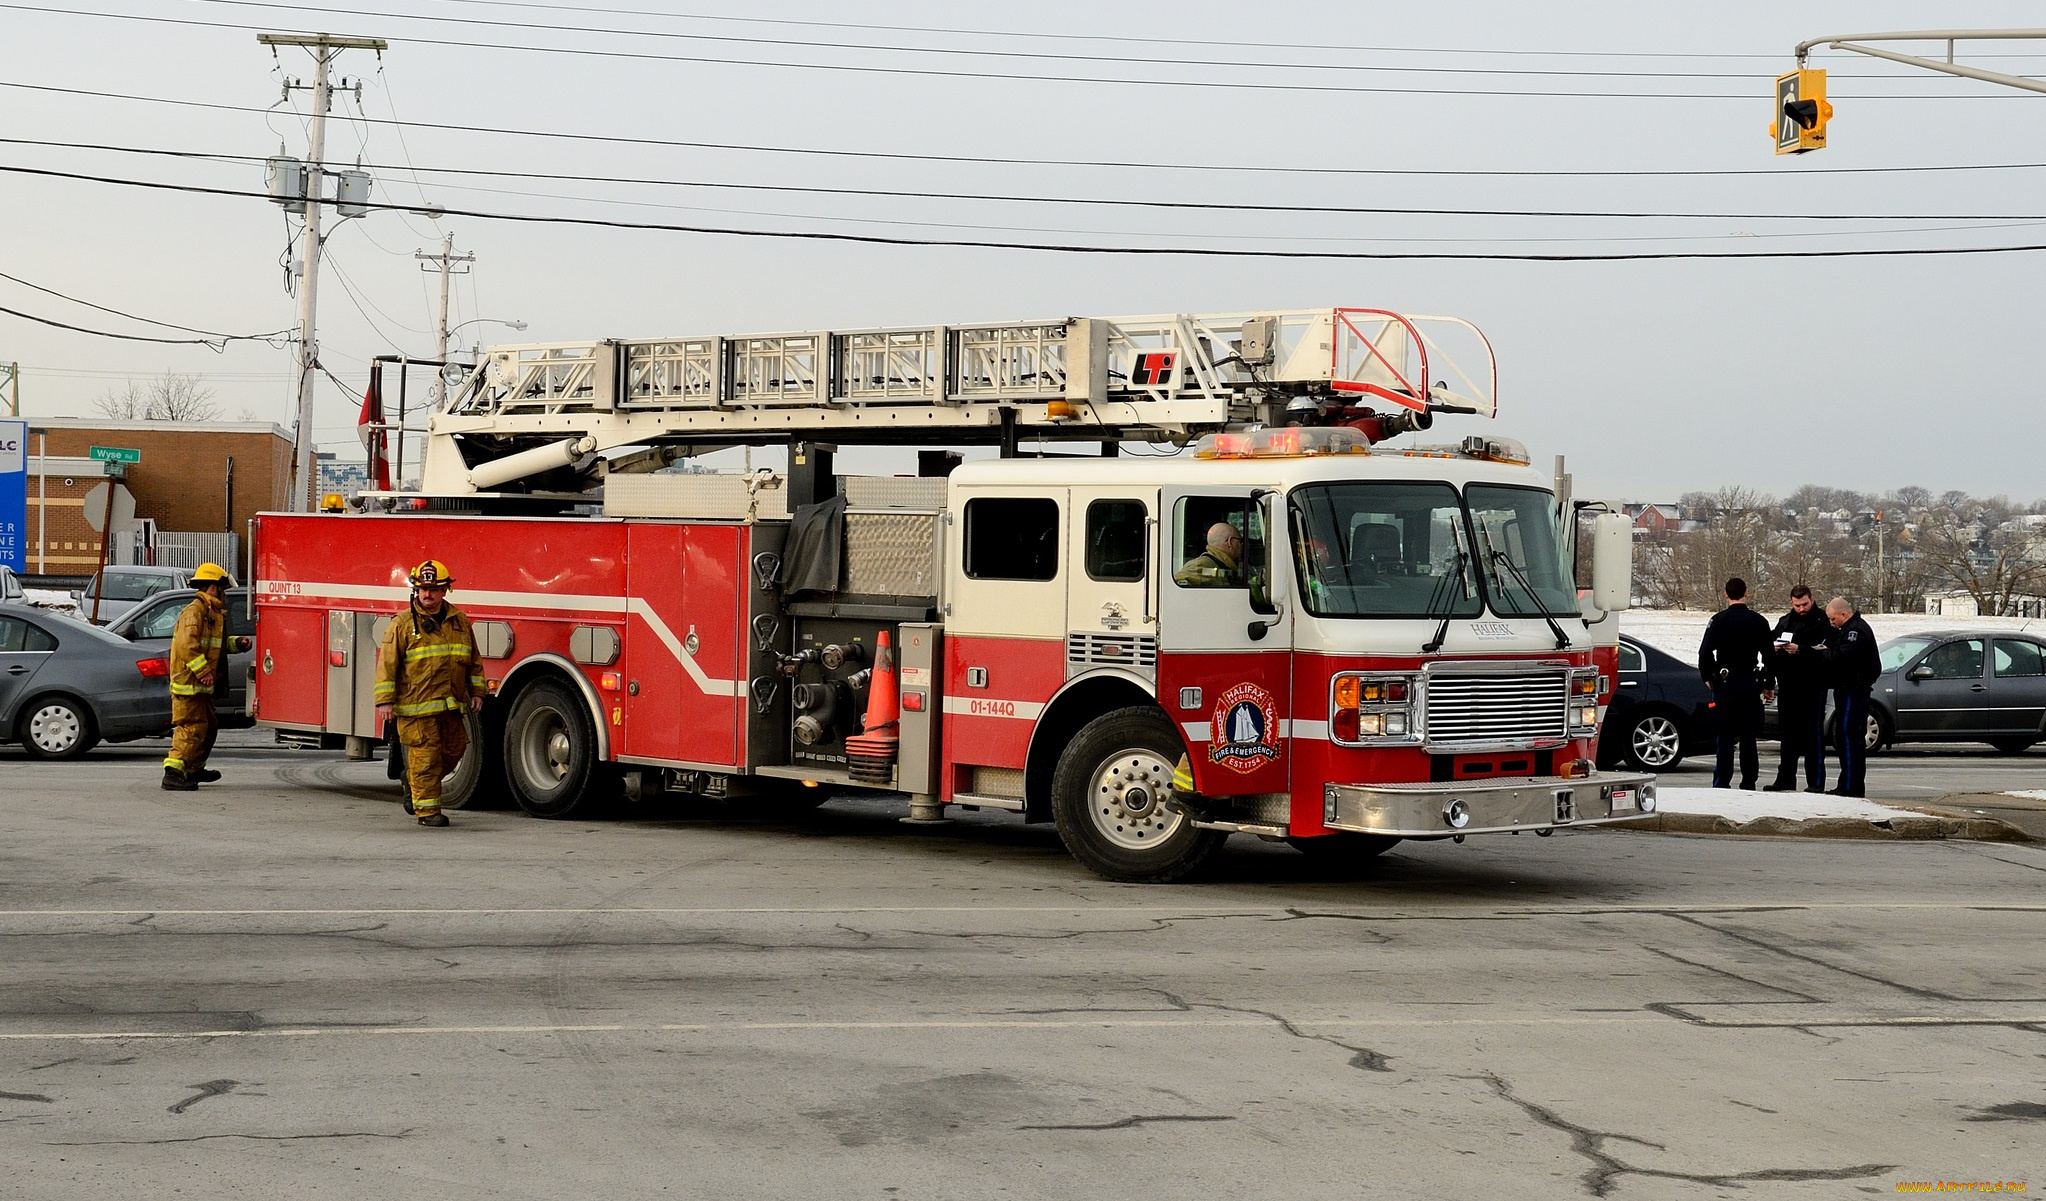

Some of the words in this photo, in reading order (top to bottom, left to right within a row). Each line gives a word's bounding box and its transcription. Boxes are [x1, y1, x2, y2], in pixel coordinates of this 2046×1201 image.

[97, 450, 122, 460] Wyse
[423, 573, 434, 581] 13
[269, 582, 291, 594] QUINT
[293, 583, 302, 595] 13
[1226, 685, 1265, 700] HALIFAX
[1230, 694, 1260, 705] REGIONAL
[970, 700, 1015, 717] 01-144Q
